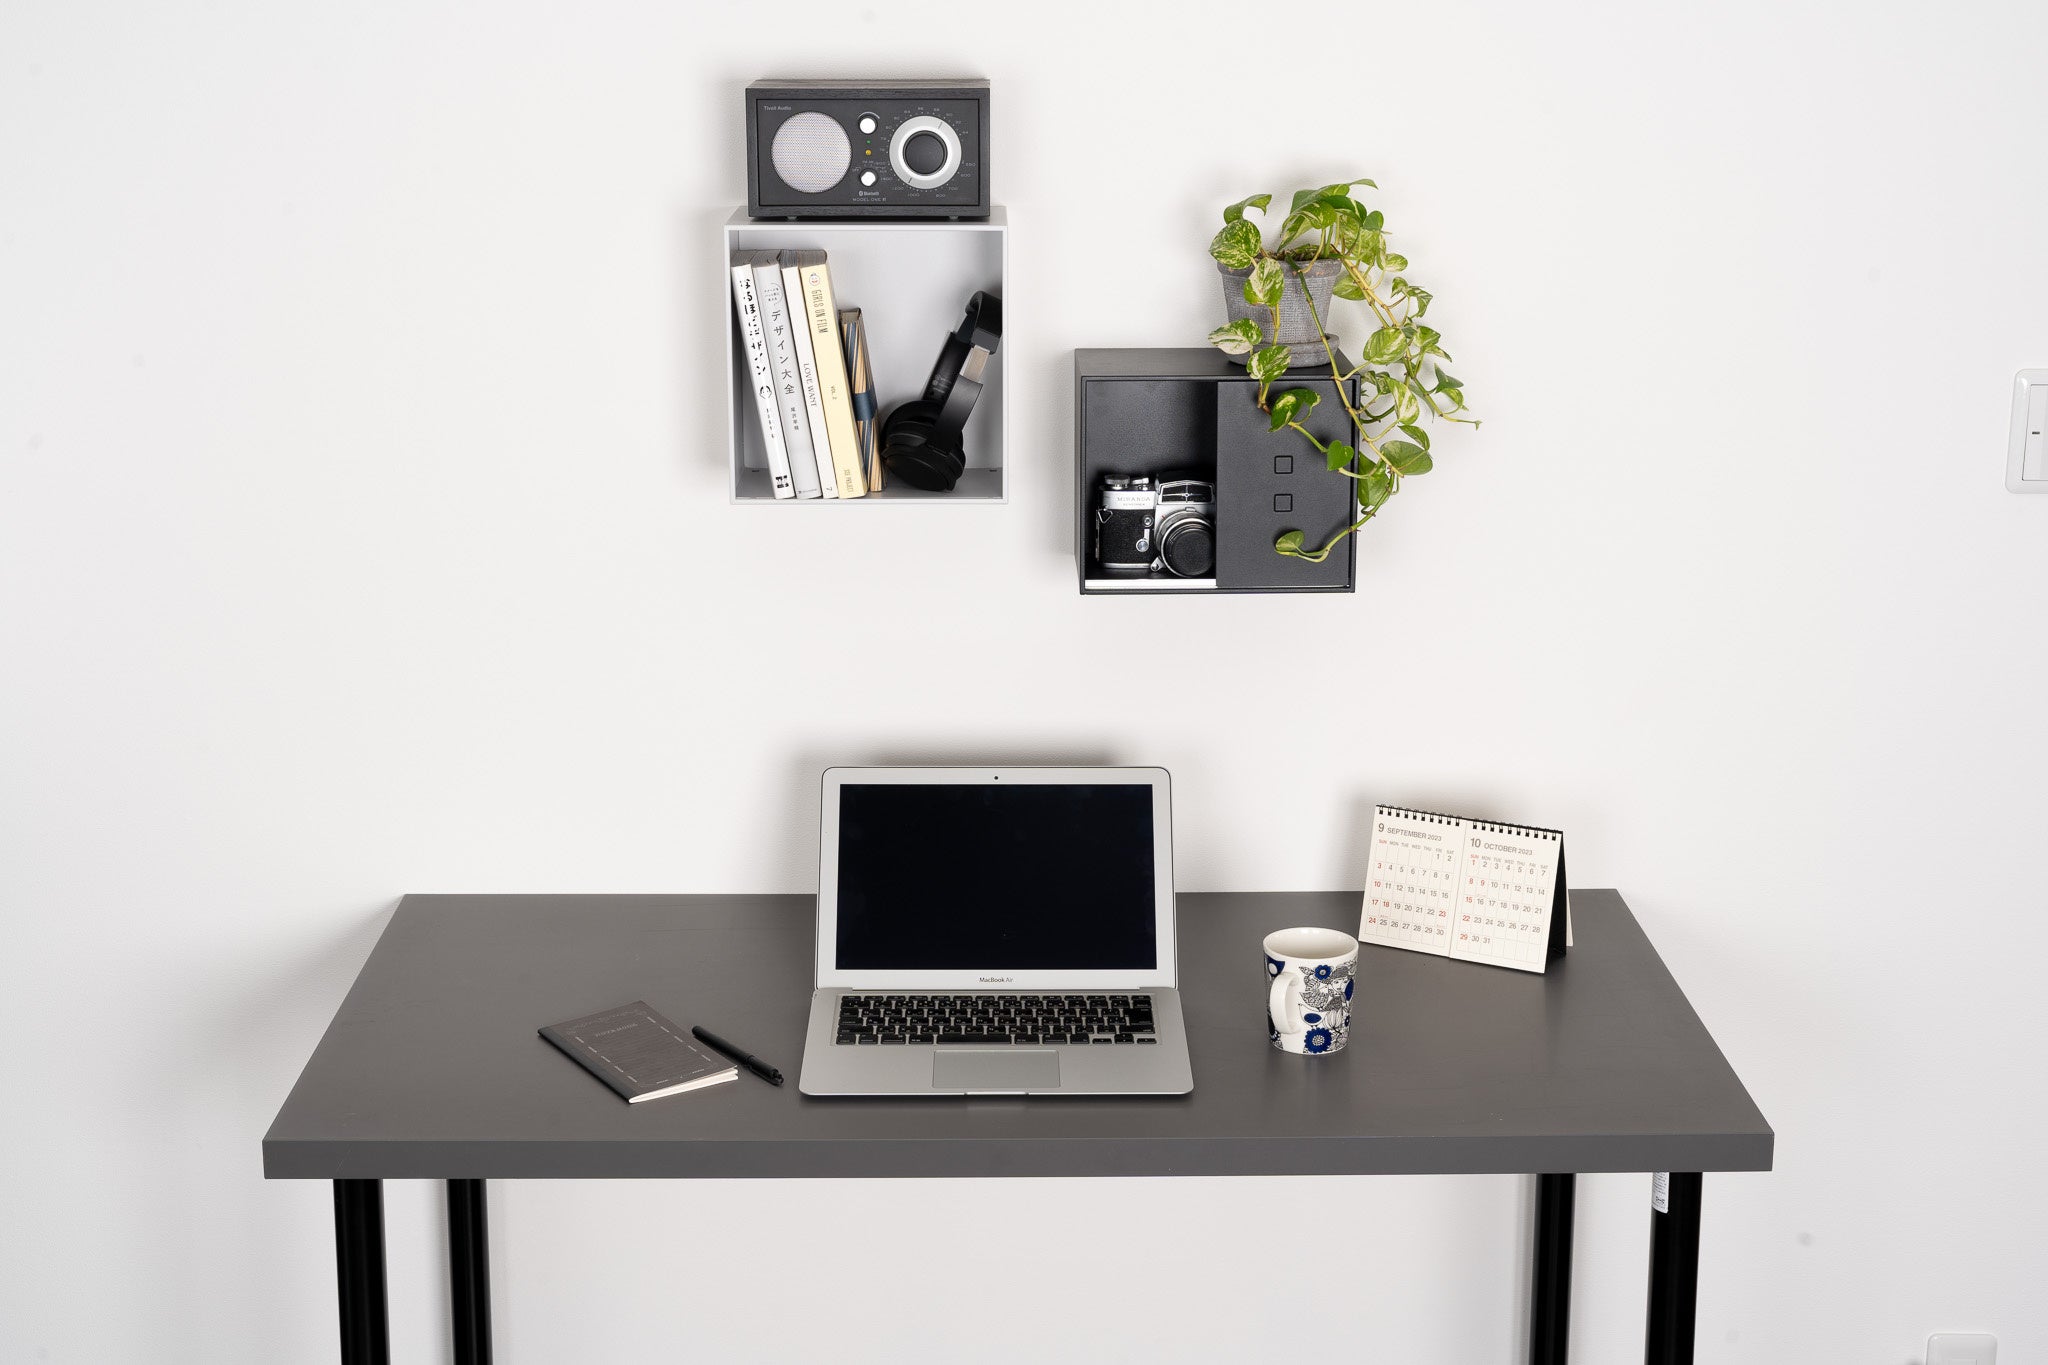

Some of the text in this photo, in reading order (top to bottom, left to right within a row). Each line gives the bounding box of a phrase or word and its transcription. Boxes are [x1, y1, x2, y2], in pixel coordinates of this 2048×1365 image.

[811, 290, 828, 333] GIRLS ON FILM
[772, 310, 794, 394] デザイン大全
[804, 363, 817, 406] LOVE WANT
[1379, 823, 1384, 832] 9
[1387, 828, 1426, 838] SEPTEMBER
[1471, 838, 1481, 848] 10
[1484, 843, 1517, 853] OCTOBER
